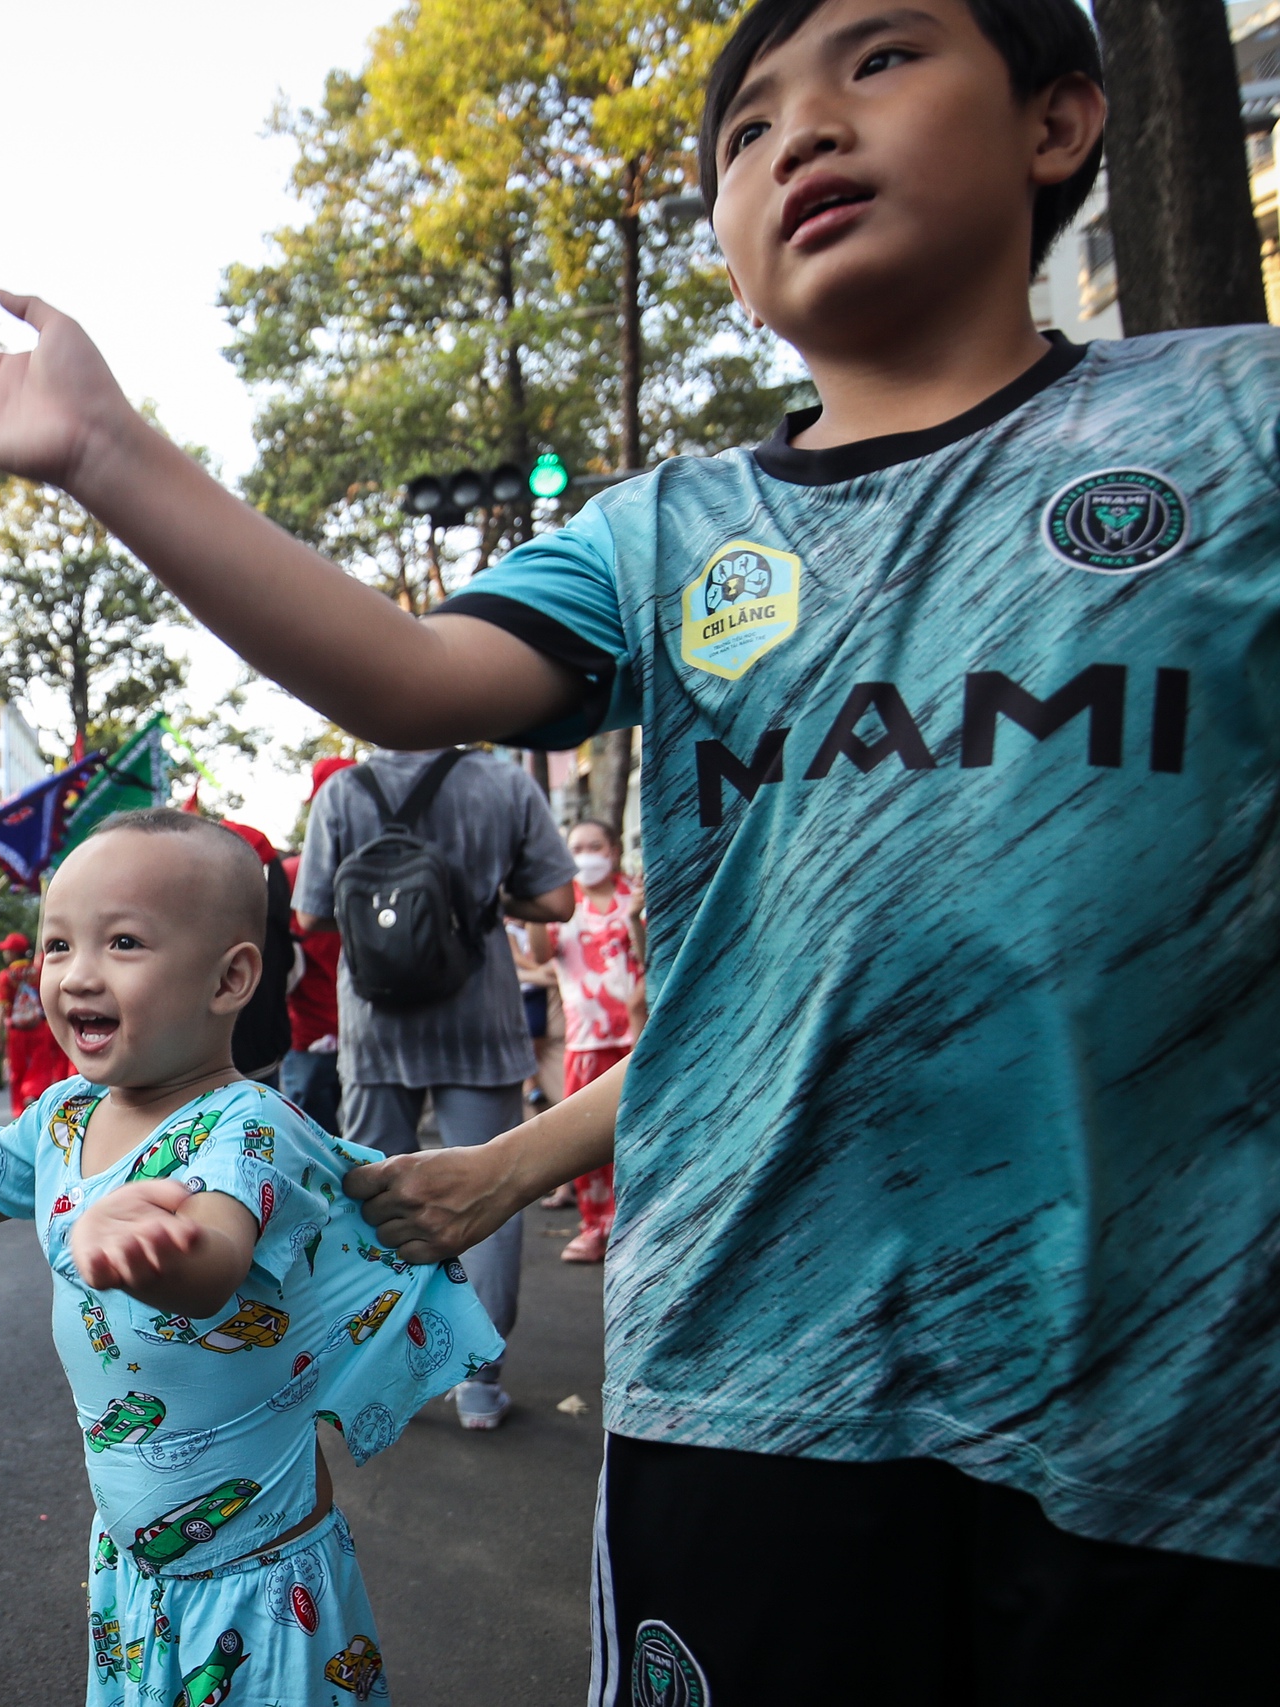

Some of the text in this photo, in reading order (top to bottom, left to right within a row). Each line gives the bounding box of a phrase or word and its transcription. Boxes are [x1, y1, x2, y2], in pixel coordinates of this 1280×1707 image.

[1091, 495, 1149, 505] MIAMI
[702, 604, 776, 640] CHI LĂNG
